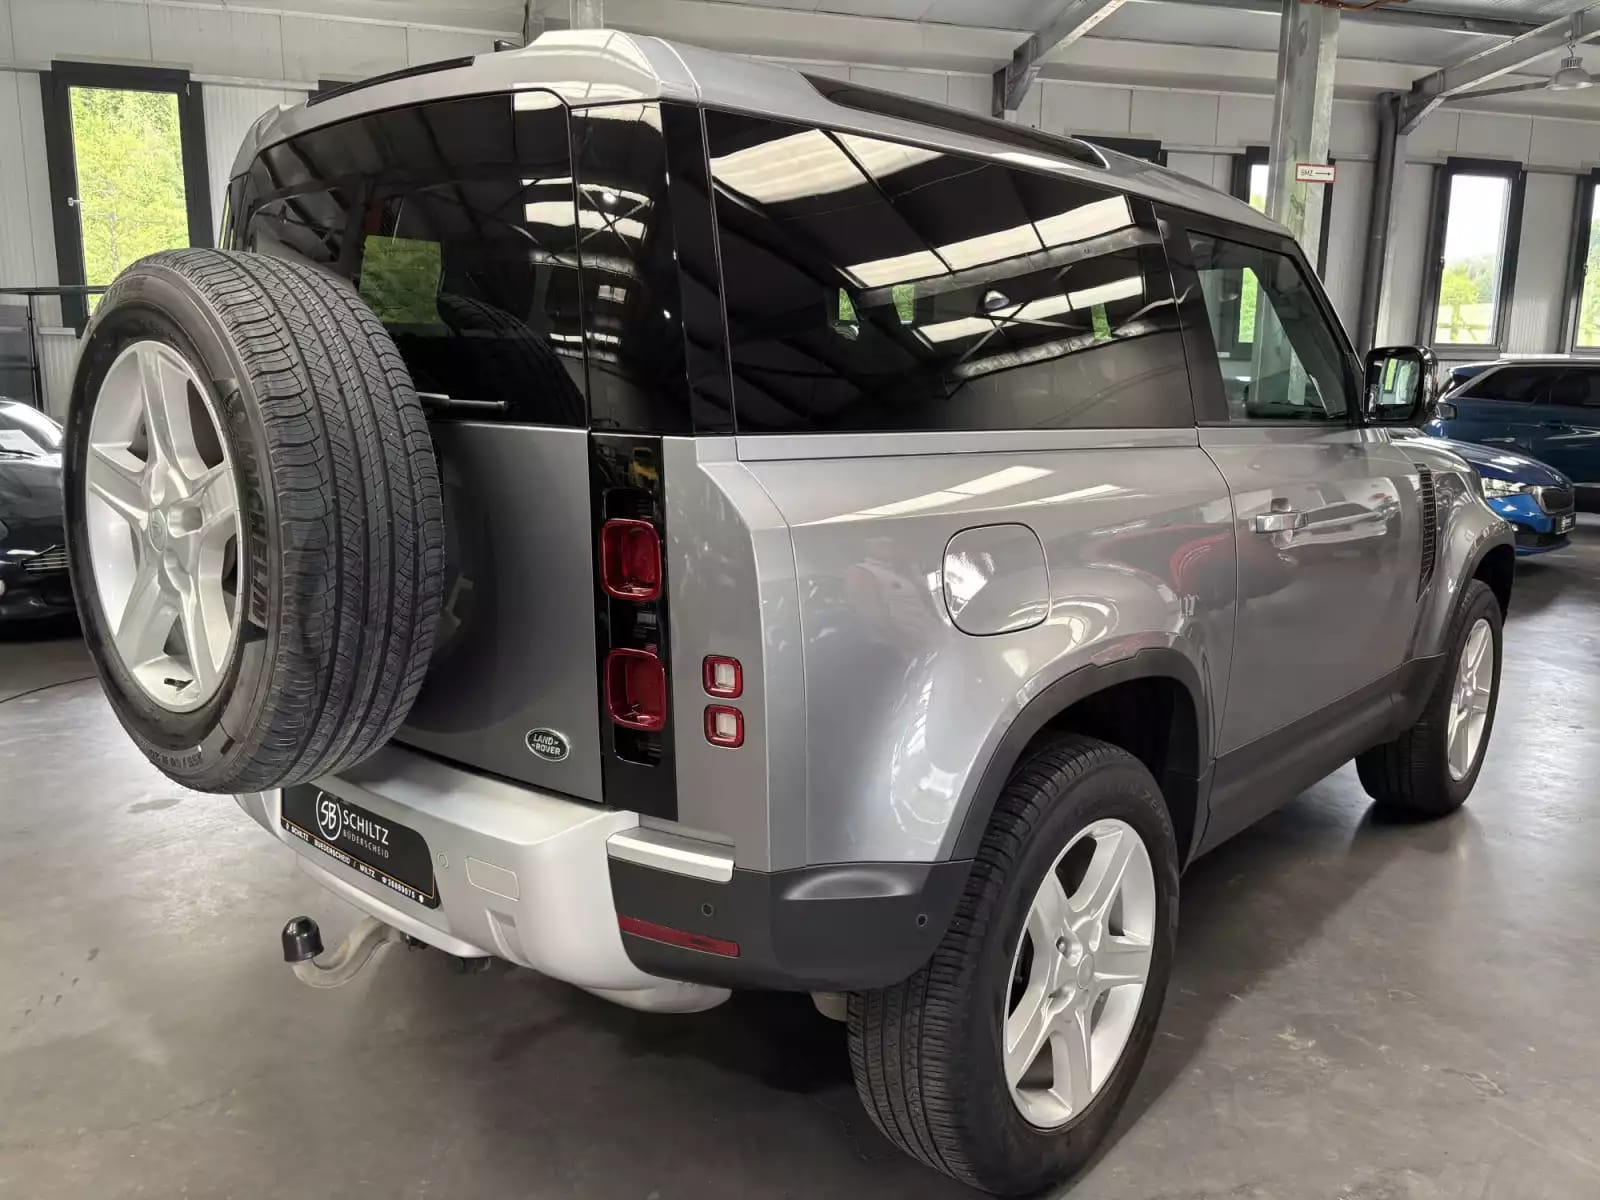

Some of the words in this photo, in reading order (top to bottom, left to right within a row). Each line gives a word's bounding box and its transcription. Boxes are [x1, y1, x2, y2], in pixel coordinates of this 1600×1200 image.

[239, 441, 268, 625] MICHELIN
[533, 733, 554, 745] LAND
[535, 743, 561, 755] ROVER
[343, 809, 389, 845] SCHILTZ
